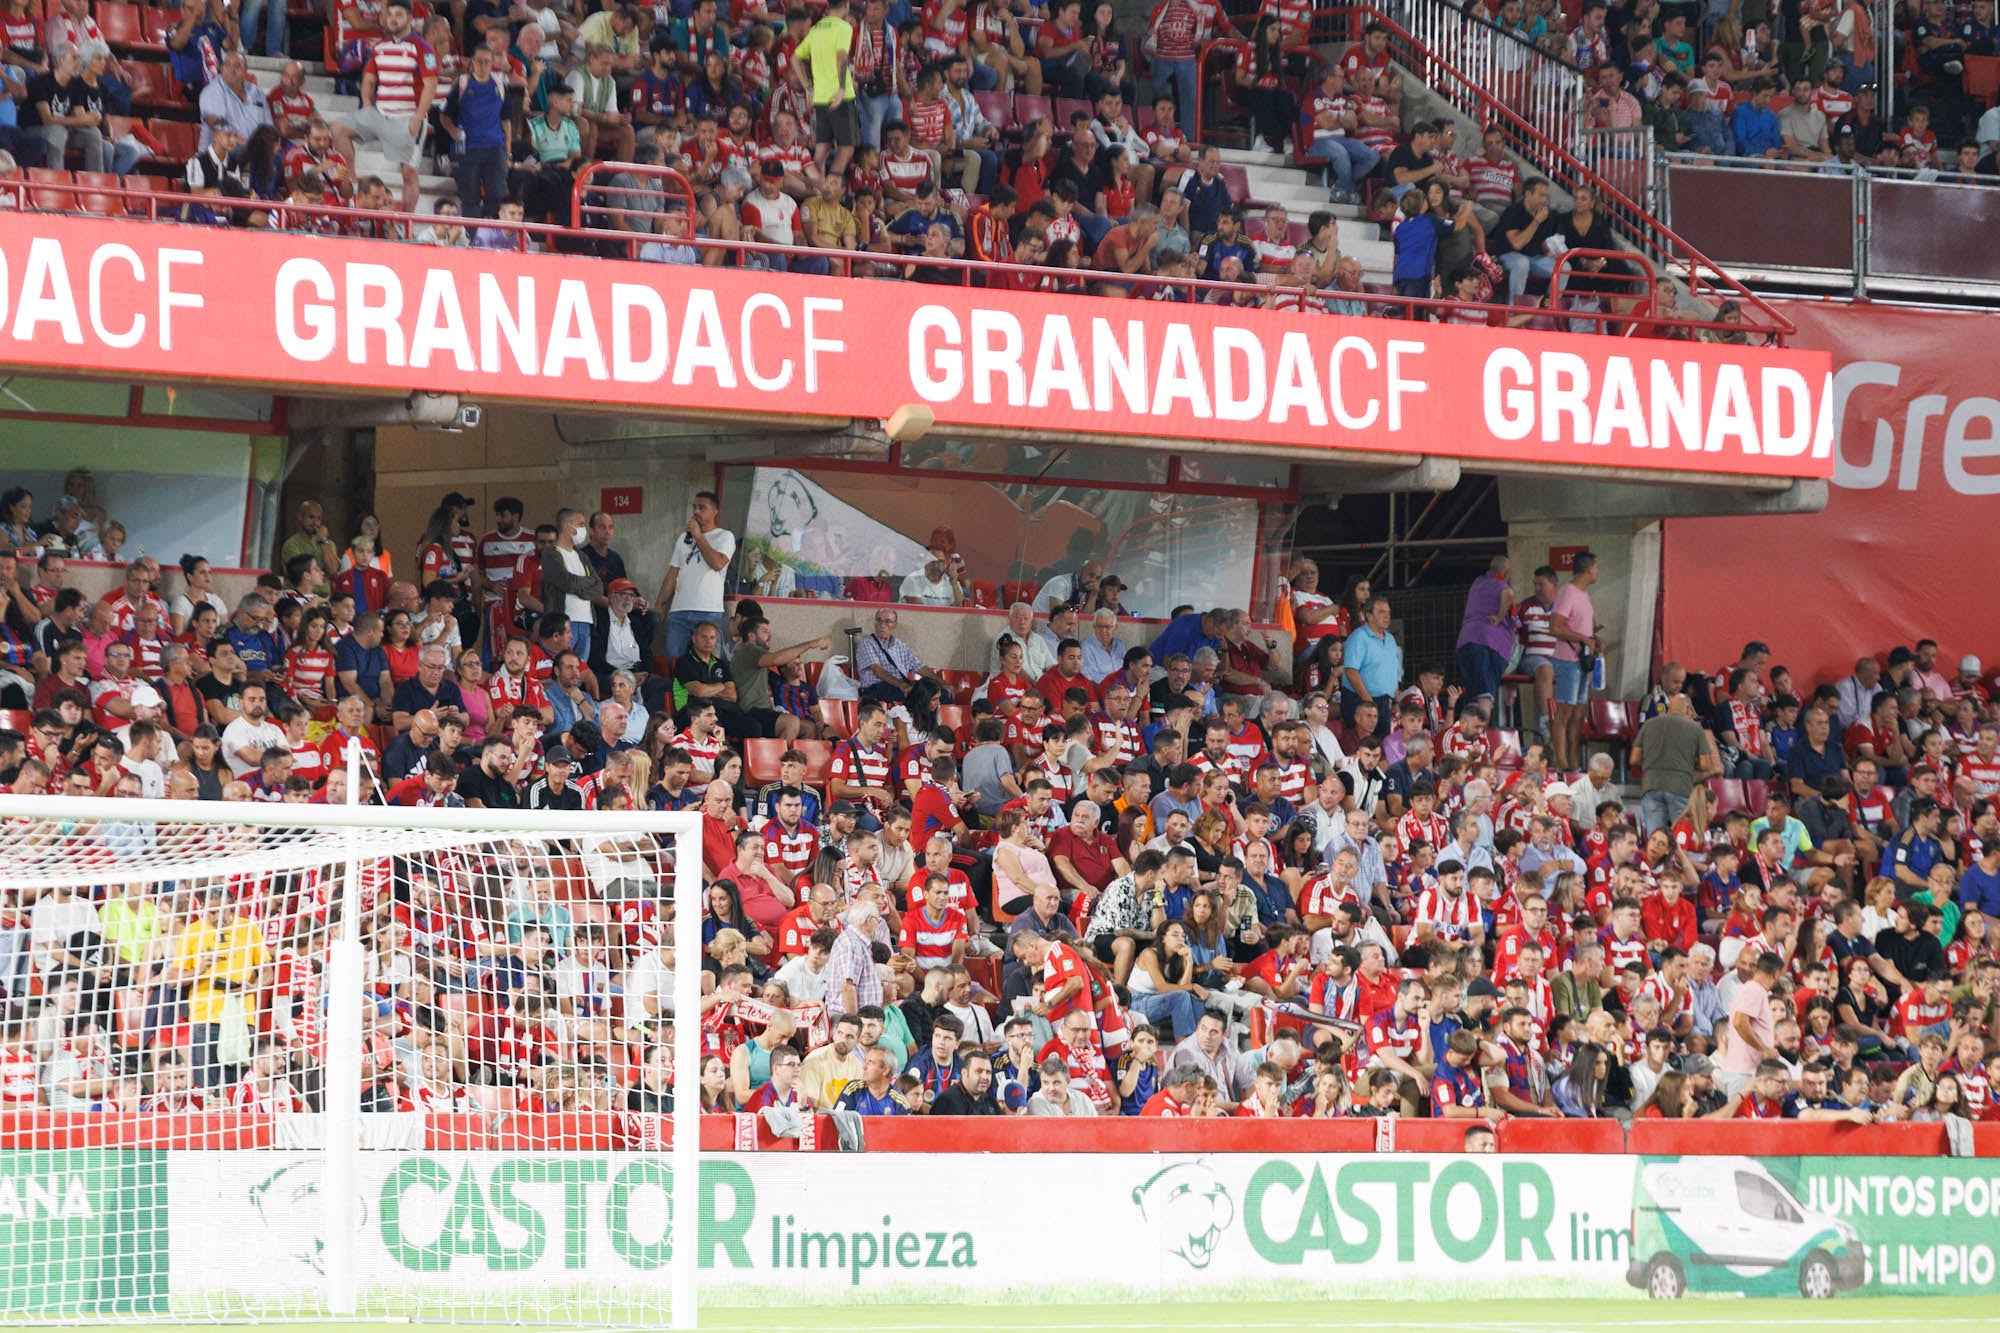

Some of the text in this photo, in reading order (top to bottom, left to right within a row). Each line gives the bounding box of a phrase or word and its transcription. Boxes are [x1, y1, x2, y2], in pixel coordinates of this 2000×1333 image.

[613, 495, 630, 507] 134
[1243, 1159, 1556, 1265] CASTOR
[1805, 1174, 2000, 1218] JUNTOS PO
[380, 1157, 977, 1286] CASTOR limpieza
[1878, 1244, 1996, 1286] LIMPIO
